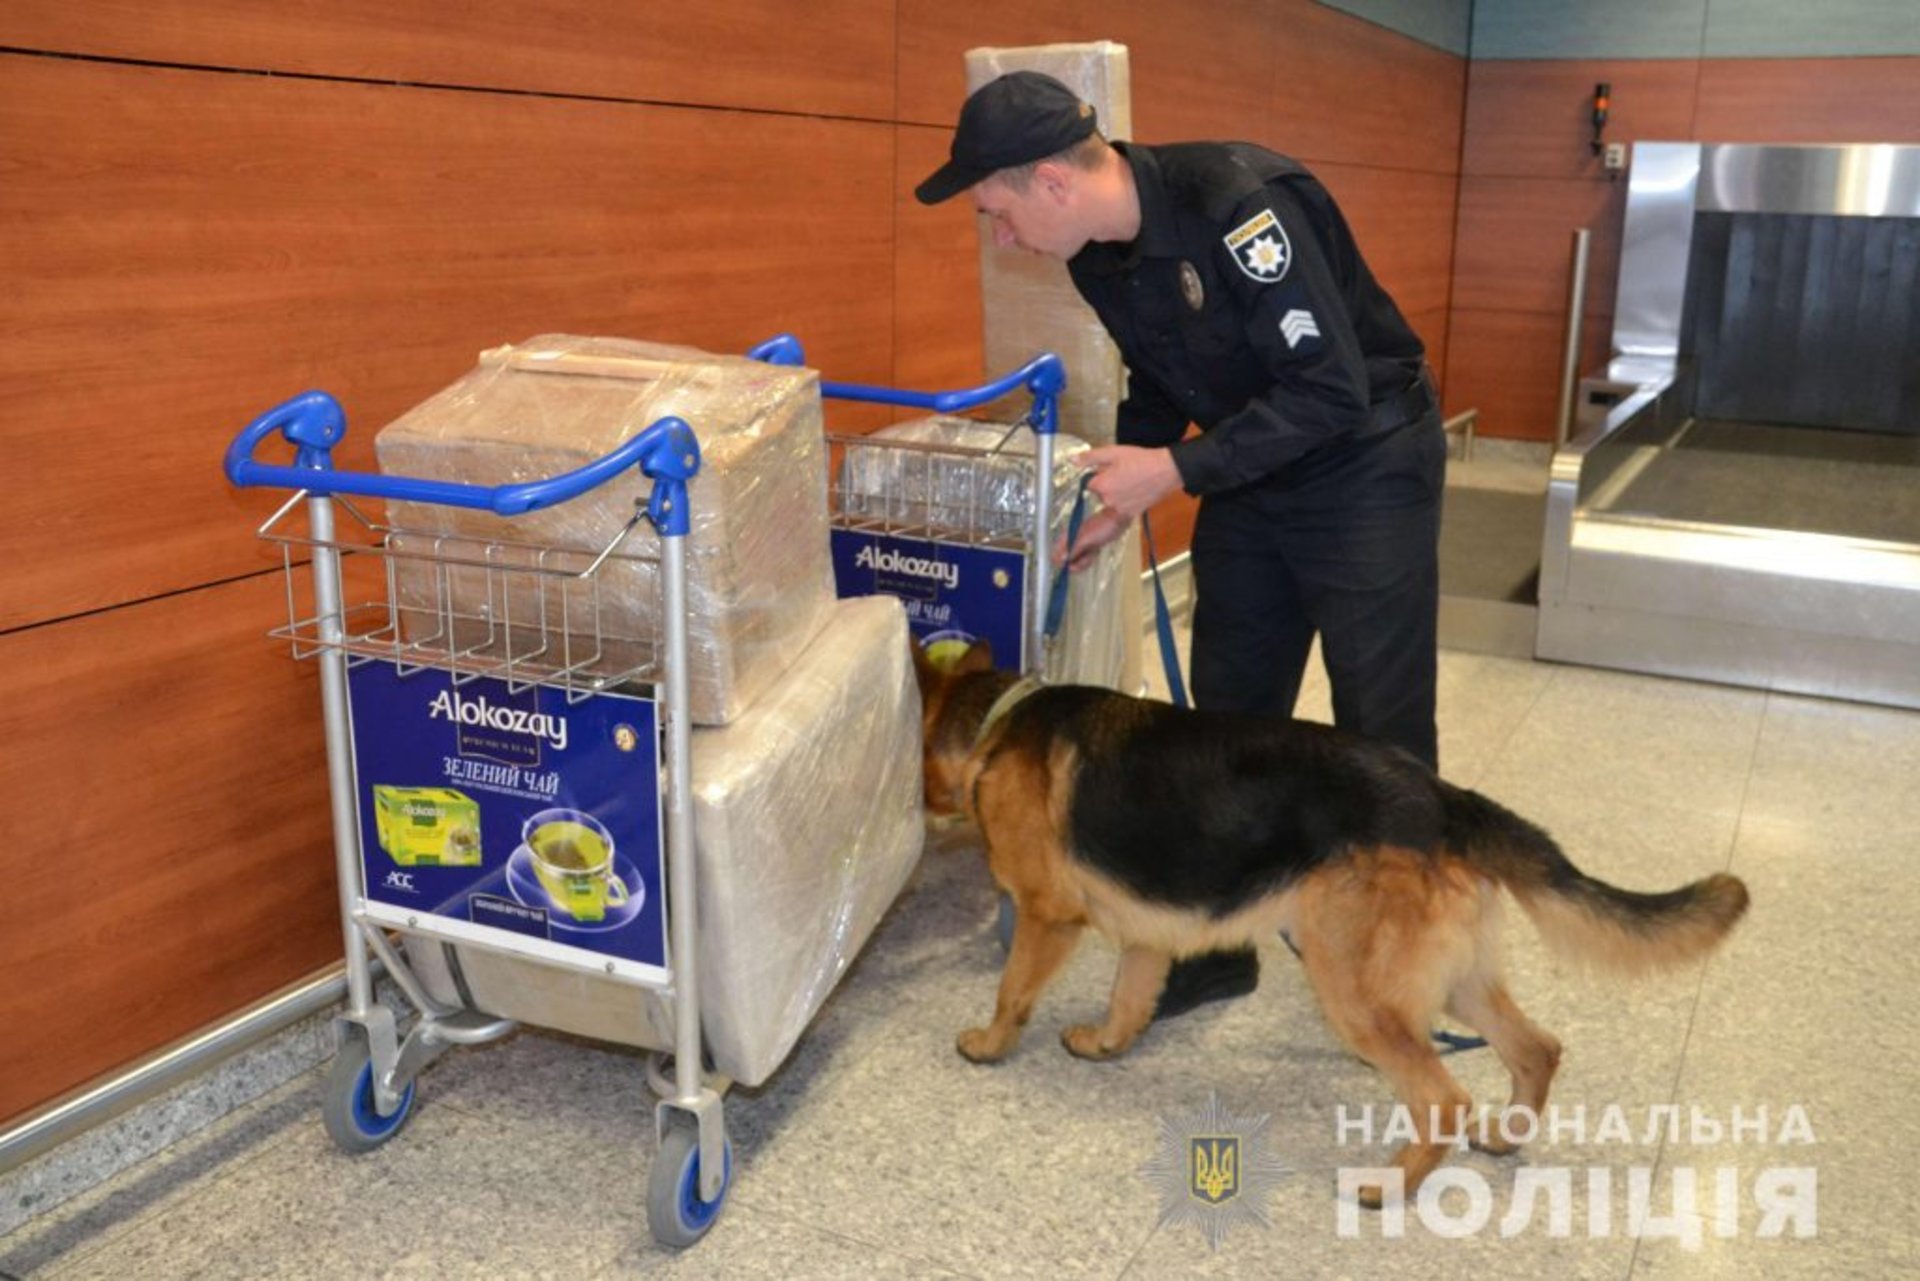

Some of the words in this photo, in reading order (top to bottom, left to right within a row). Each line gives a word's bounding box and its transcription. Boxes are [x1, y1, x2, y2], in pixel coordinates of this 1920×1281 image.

[854, 545, 960, 590] Alokozay
[428, 689, 568, 751] Alokozay
[442, 757, 520, 788] ЗЕЛЕНИЙ
[523, 771, 561, 795] ЧАЙ
